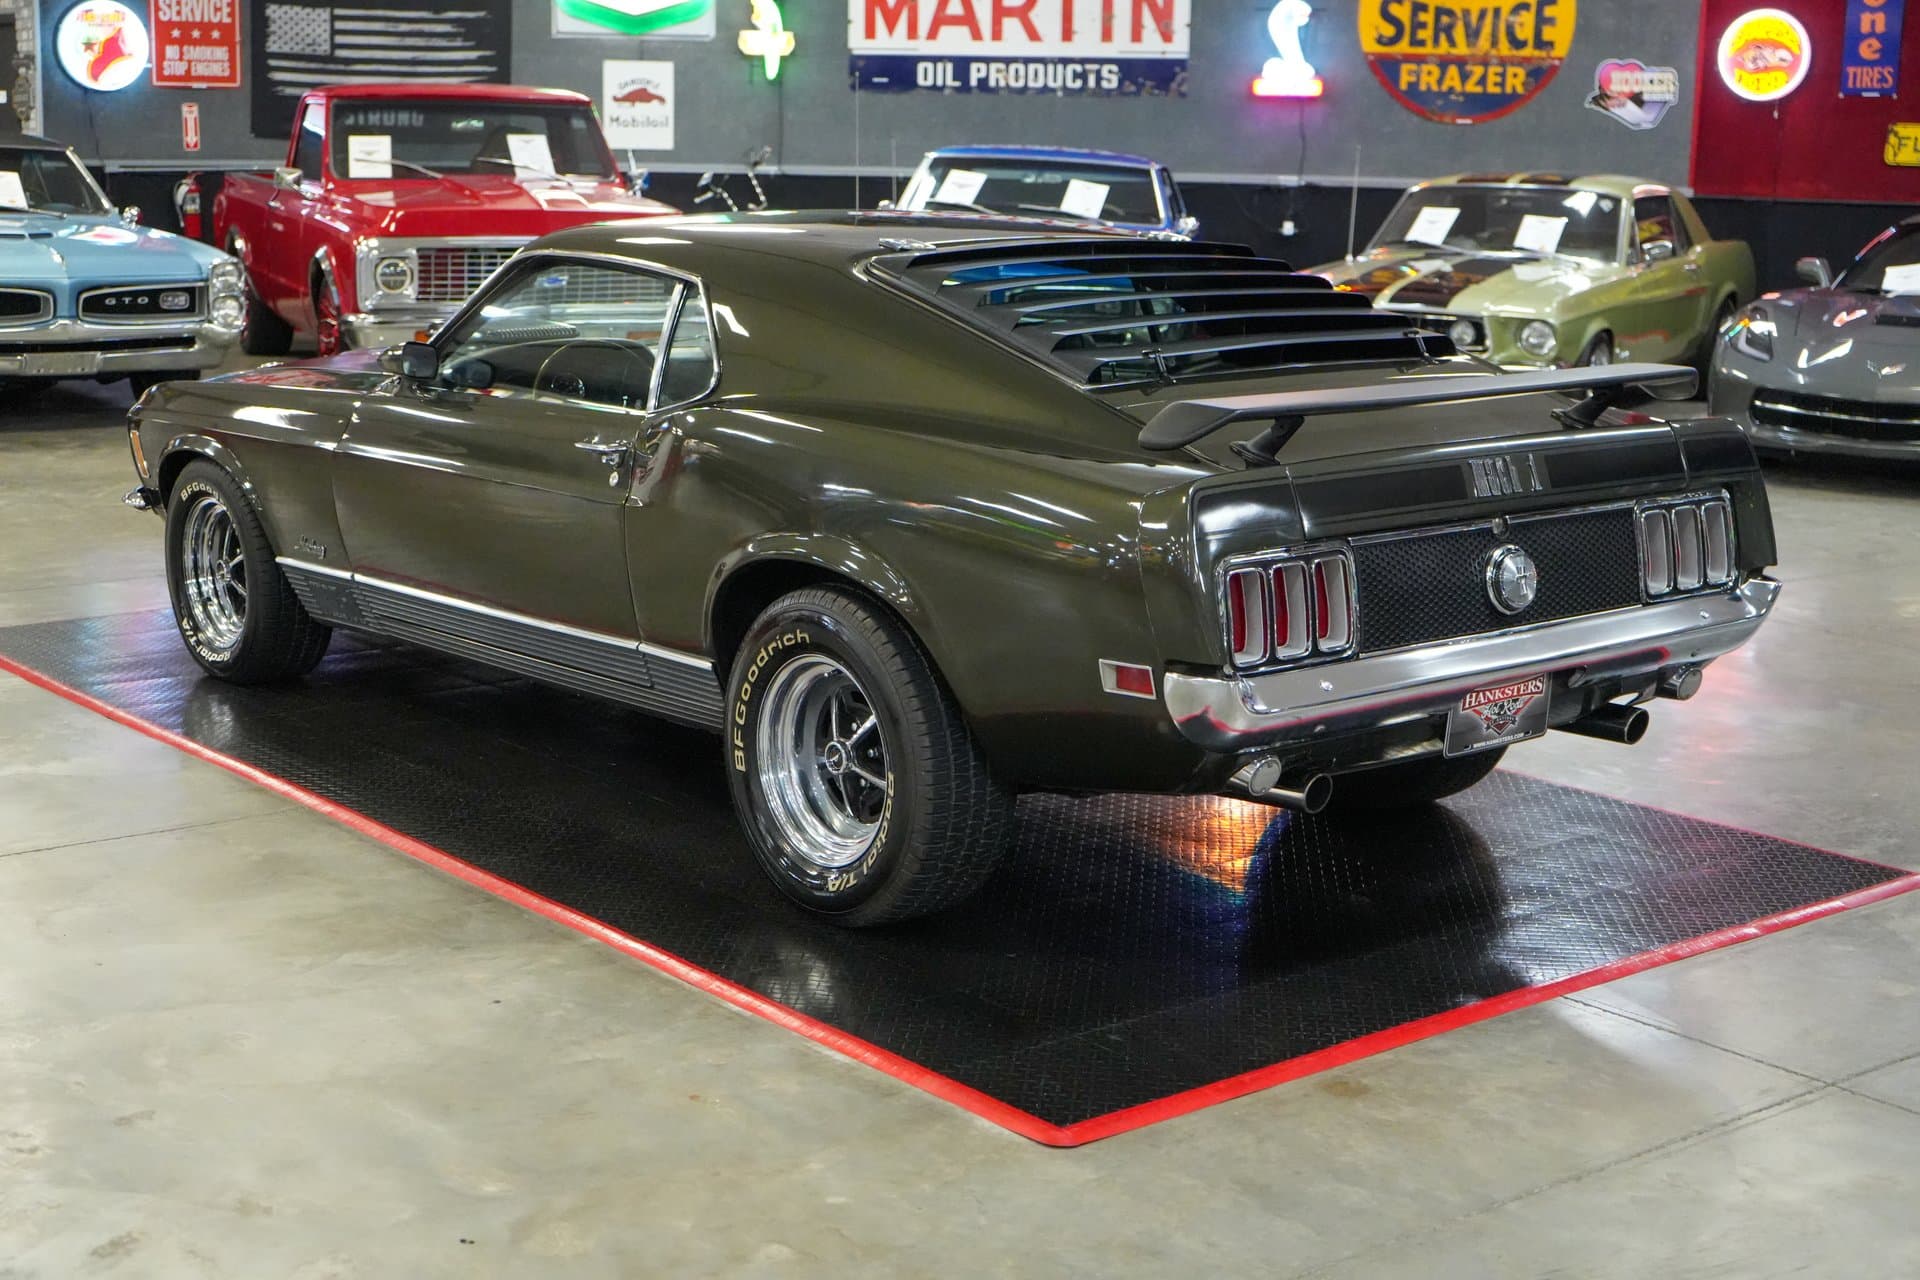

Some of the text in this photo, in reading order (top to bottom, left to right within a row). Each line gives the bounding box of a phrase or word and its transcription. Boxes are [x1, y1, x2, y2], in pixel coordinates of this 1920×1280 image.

[158, 0, 232, 23] SERVICE
[1375, 0, 1559, 50] SERVICE
[165, 45, 229, 61] NO SMOKING
[163, 60, 230, 77] STOP ENGINES
[916, 61, 1120, 90] OIL PRODUCTS
[1398, 63, 1528, 95] FRAZER
[1846, 65, 1895, 90] TIRES
[104, 295, 150, 306] GTO
[734, 628, 811, 773] BFGoodrich
[1463, 676, 1544, 709] HANKSTERS
[827, 771, 895, 893] Radial T/A
